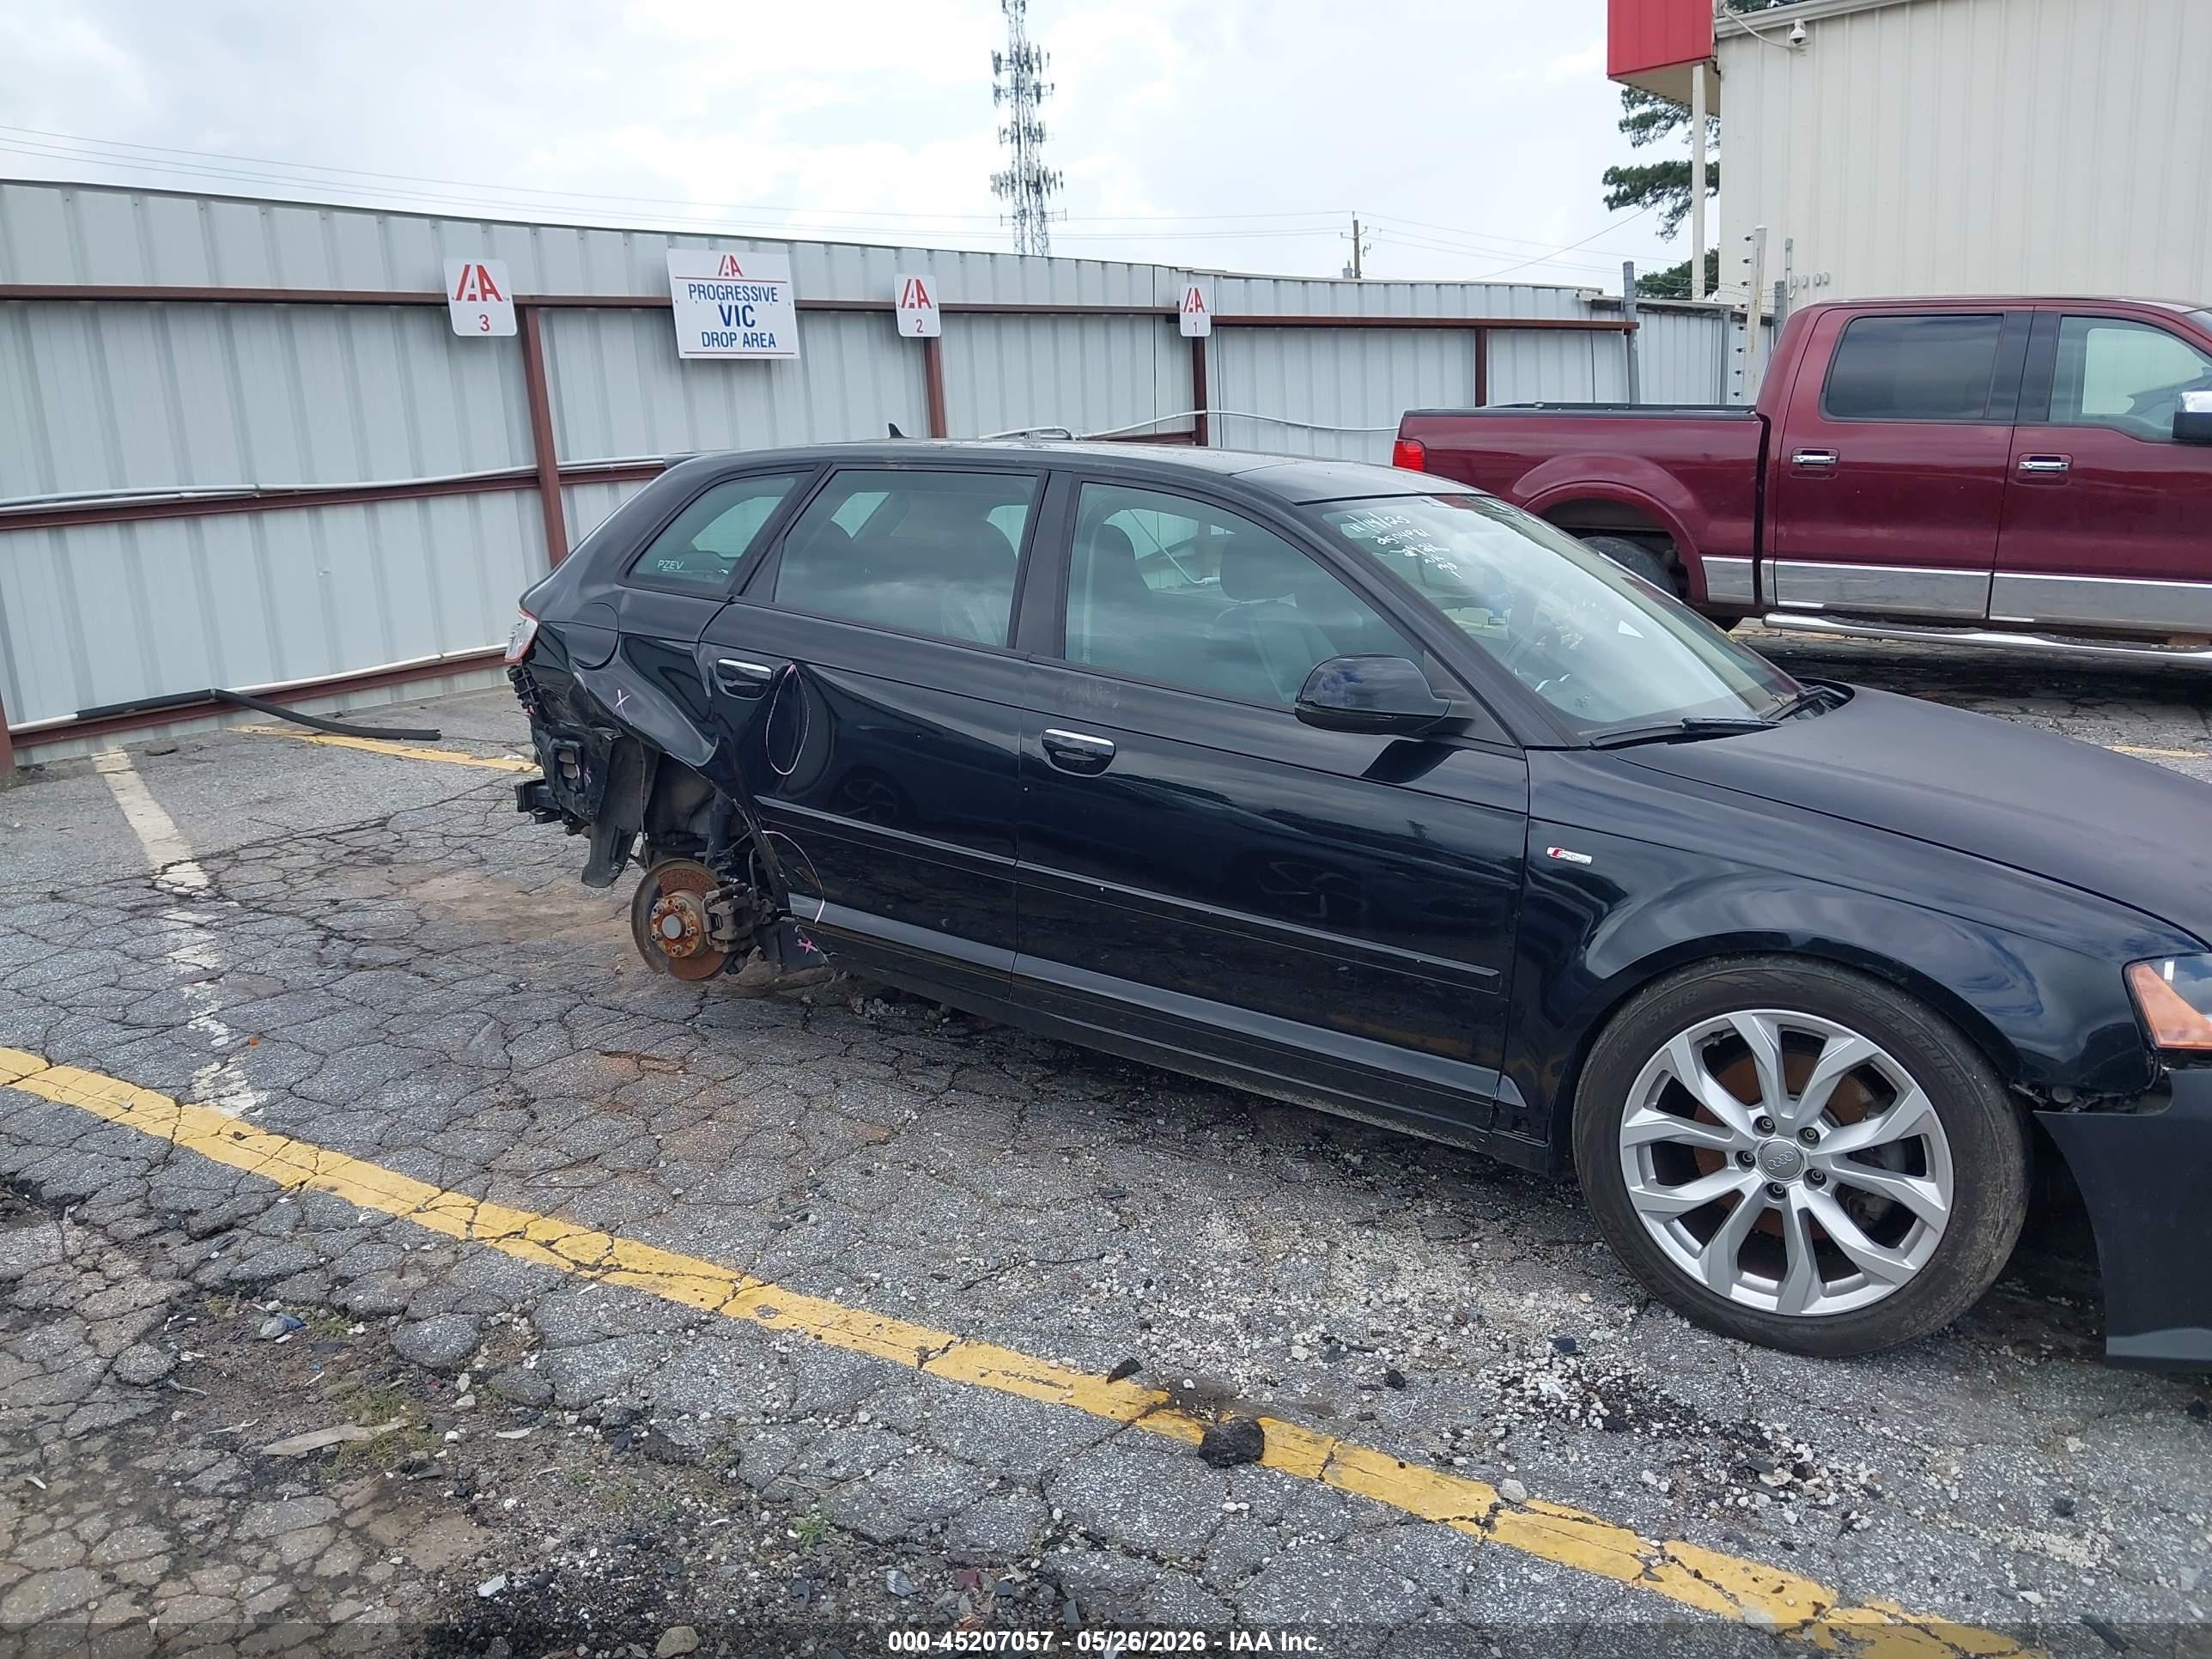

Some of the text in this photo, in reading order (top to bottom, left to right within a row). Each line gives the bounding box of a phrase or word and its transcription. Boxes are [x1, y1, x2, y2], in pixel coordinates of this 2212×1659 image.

[688, 283, 779, 302] PROGRESSIVE
[478, 314, 490, 331] 3
[718, 304, 756, 328] VIC
[915, 319, 924, 333] 2
[1194, 321, 1198, 334] 1
[701, 331, 777, 348] DROP AREA
[657, 559, 684, 570] PZEV
